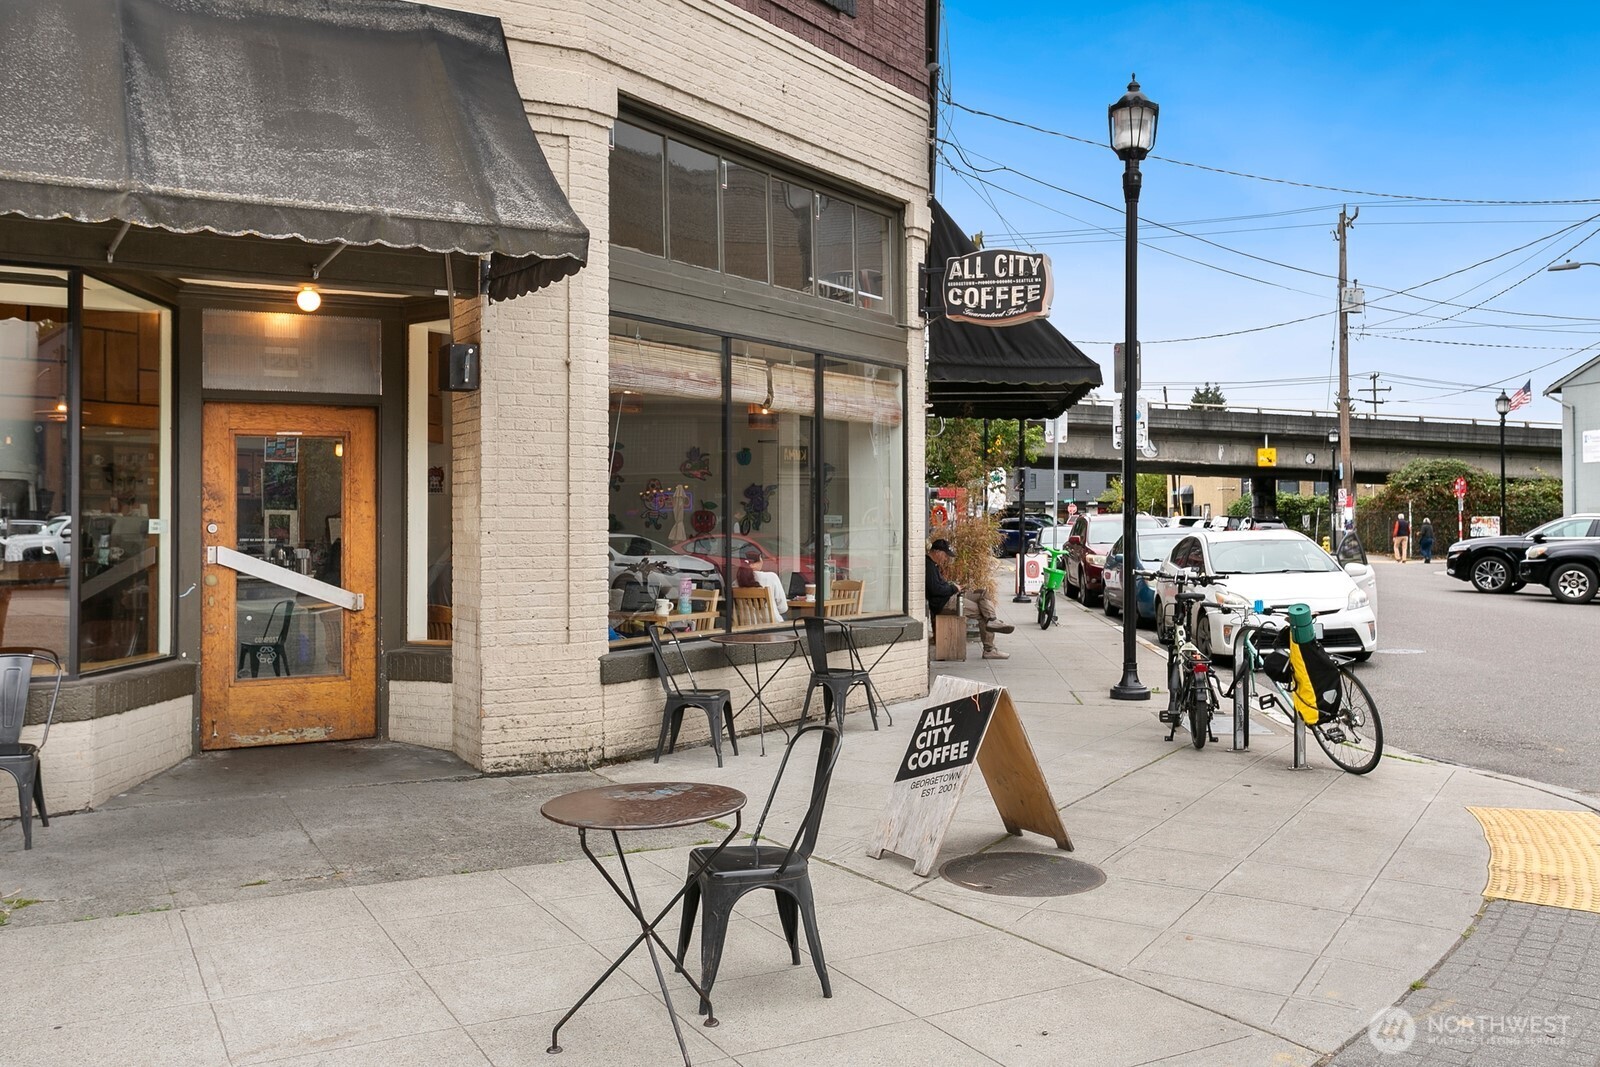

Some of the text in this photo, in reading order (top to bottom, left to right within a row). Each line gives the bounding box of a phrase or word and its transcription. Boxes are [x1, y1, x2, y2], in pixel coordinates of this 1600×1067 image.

[948, 253, 1042, 280] ALL CITY
[948, 284, 1041, 309] COFFEE
[962, 304, 1028, 318] Guaranteed Fresh
[922, 706, 952, 730] ALL
[915, 724, 955, 750] CITY
[907, 740, 970, 771] COFFEE
[910, 771, 961, 790] GEORGETOWN
[920, 783, 957, 798] EST. 2001
